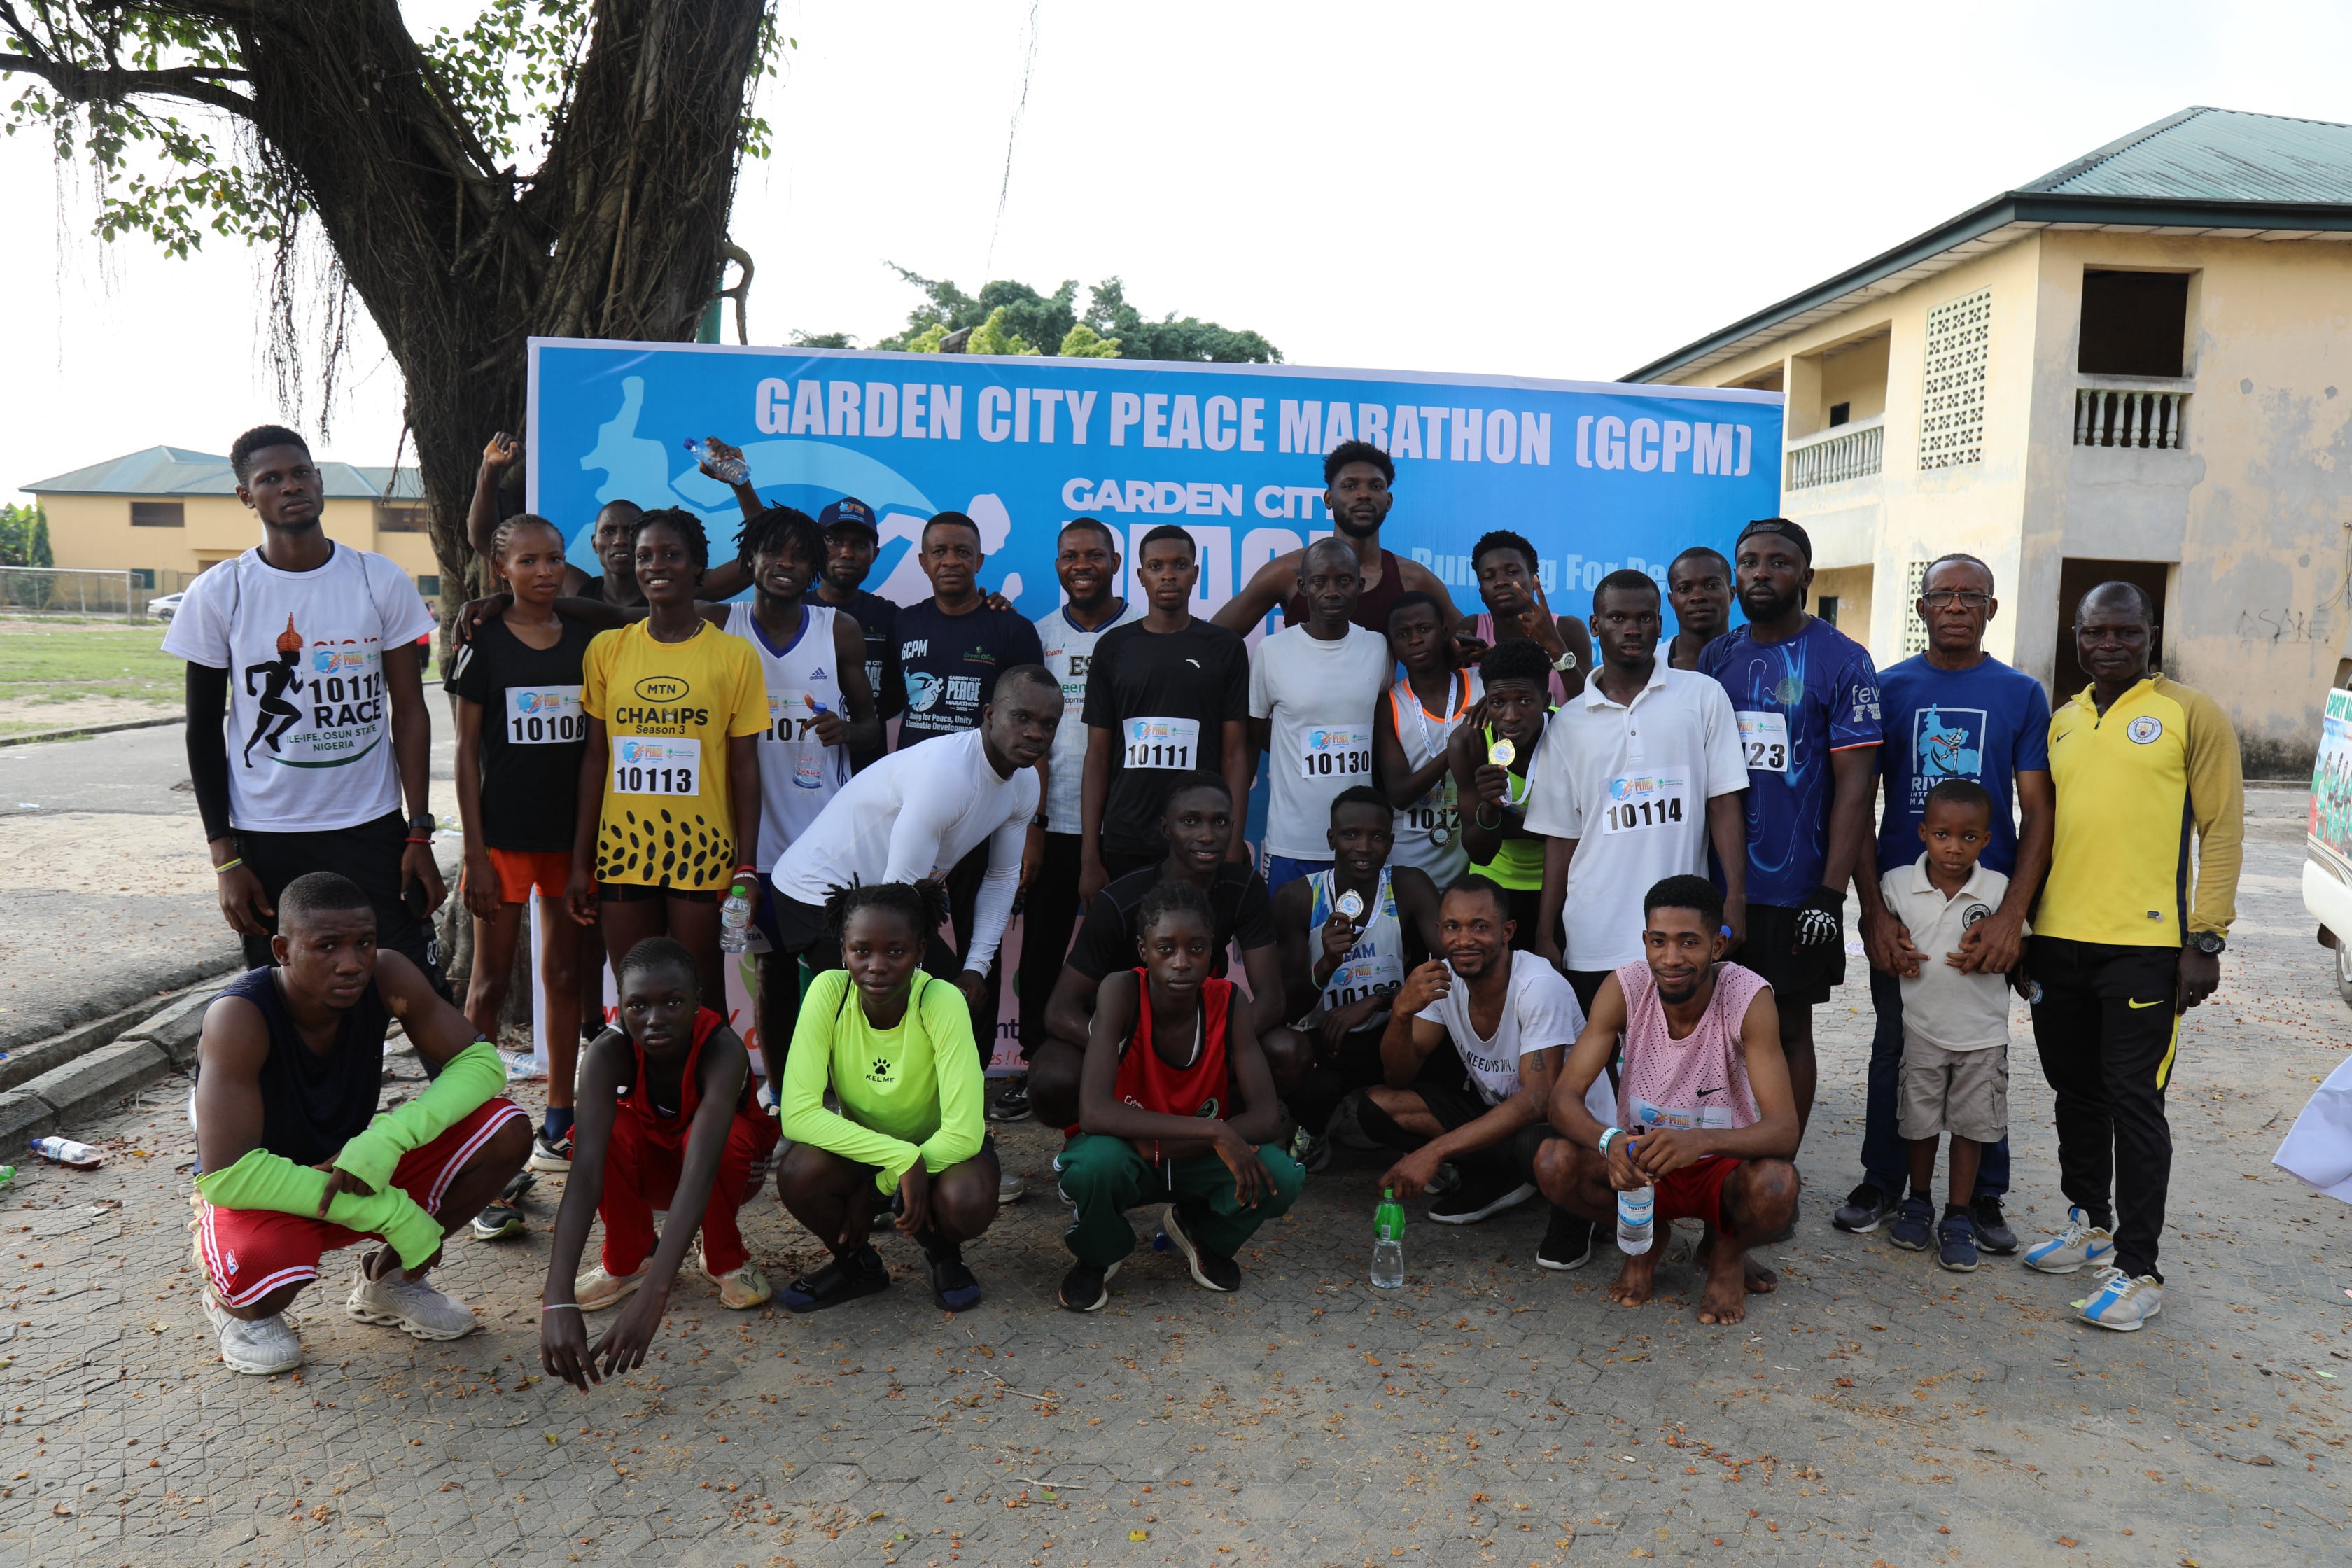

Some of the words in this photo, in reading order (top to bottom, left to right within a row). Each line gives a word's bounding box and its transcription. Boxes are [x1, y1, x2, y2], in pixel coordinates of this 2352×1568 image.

[755, 377, 962, 440] GARDEN
[977, 386, 1098, 444] CITY
[1110, 391, 1265, 452] PEACE
[1278, 399, 1551, 465] MARATHON
[1576, 415, 1752, 477] (GCPM)
[1061, 477, 1243, 517] GARDEN
[902, 639, 928, 660] GCPM
[308, 671, 381, 704] 10112
[648, 684, 676, 694] MTN
[946, 680, 981, 701] PEACE
[314, 699, 382, 729] RACE
[617, 707, 708, 726] CHAMPS
[932, 713, 953, 723] Peace,
[955, 715, 972, 725] Unity
[287, 733, 321, 743] ILE-IFE,
[323, 730, 352, 740] OSUN
[356, 724, 377, 736] STATE
[512, 715, 585, 741] 10108
[636, 724, 676, 734] Season
[679, 725, 685, 734] 3
[313, 741, 355, 752] NIGERIA
[1128, 744, 1188, 767] 10111
[1305, 750, 1369, 775] 10130
[617, 766, 692, 793] 10113
[1607, 797, 1682, 830] 10114
[1344, 942, 1376, 963] EAM
[1466, 1051, 1490, 1072] NEED
[1491, 1059, 1499, 1072] IS
[866, 1074, 895, 1083] KELME
